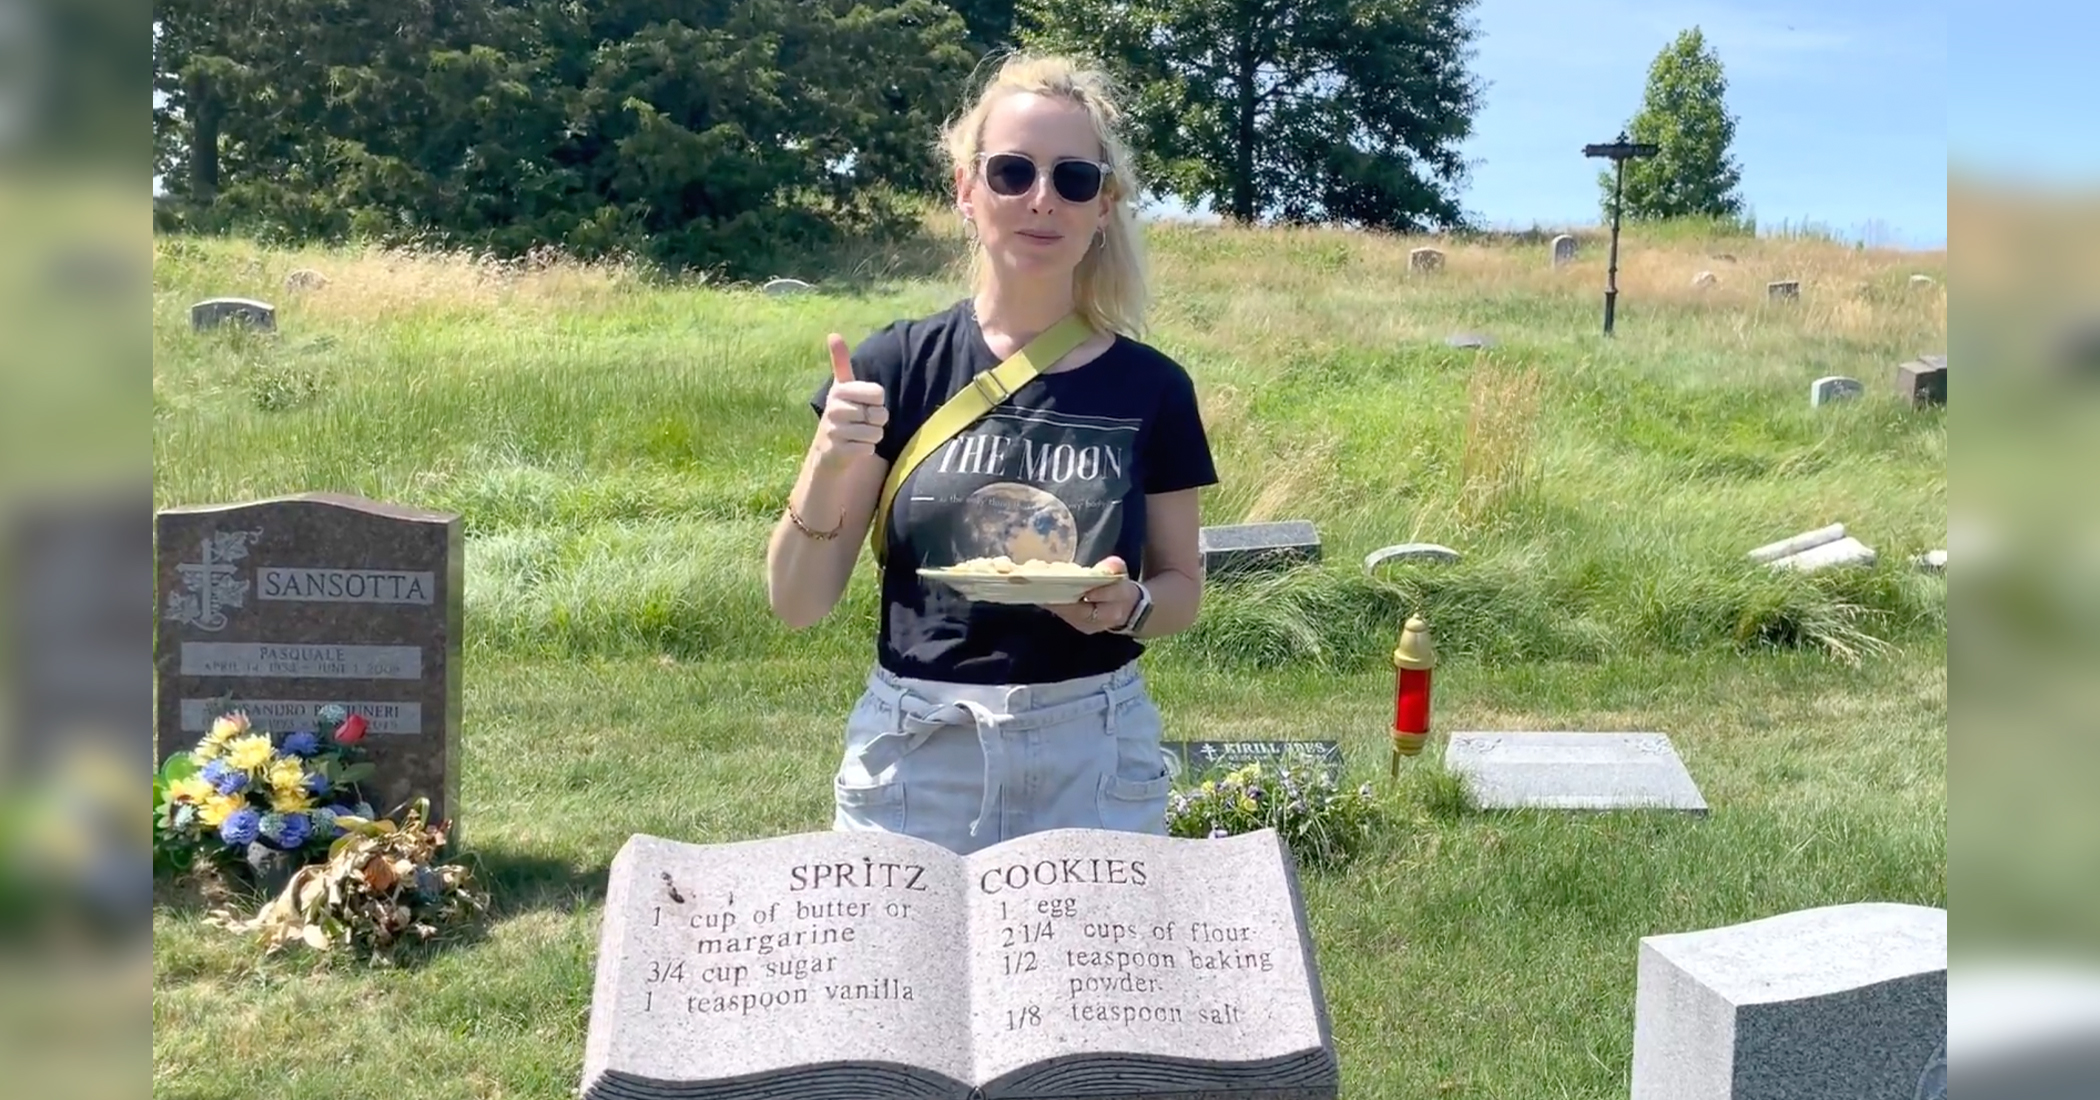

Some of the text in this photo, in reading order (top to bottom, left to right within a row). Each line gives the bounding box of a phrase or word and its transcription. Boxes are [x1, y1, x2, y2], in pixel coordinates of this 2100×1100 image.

[938, 434, 1122, 483] THE MOON
[265, 571, 427, 600] SANSOTTA
[259, 647, 346, 662] PASQUALE
[1223, 742, 1280, 755] KIRILL
[789, 858, 1148, 895] SPRITZ COOKIES
[652, 900, 912, 933] 1 cup of butter or
[1001, 898, 1077, 920] 1 egg
[698, 926, 856, 955] margarine
[1084, 922, 1136, 943] cups
[1153, 921, 1175, 942] of
[1191, 922, 1251, 943] flour
[647, 955, 838, 985] 3/4 cup sugar
[1003, 949, 1273, 975] 1/2 teaspoon baking
[644, 979, 914, 1014] 1 teaspoon vanilla
[1070, 975, 1159, 998] powder
[1006, 1003, 1240, 1031] 1/8 teaspoon salt
